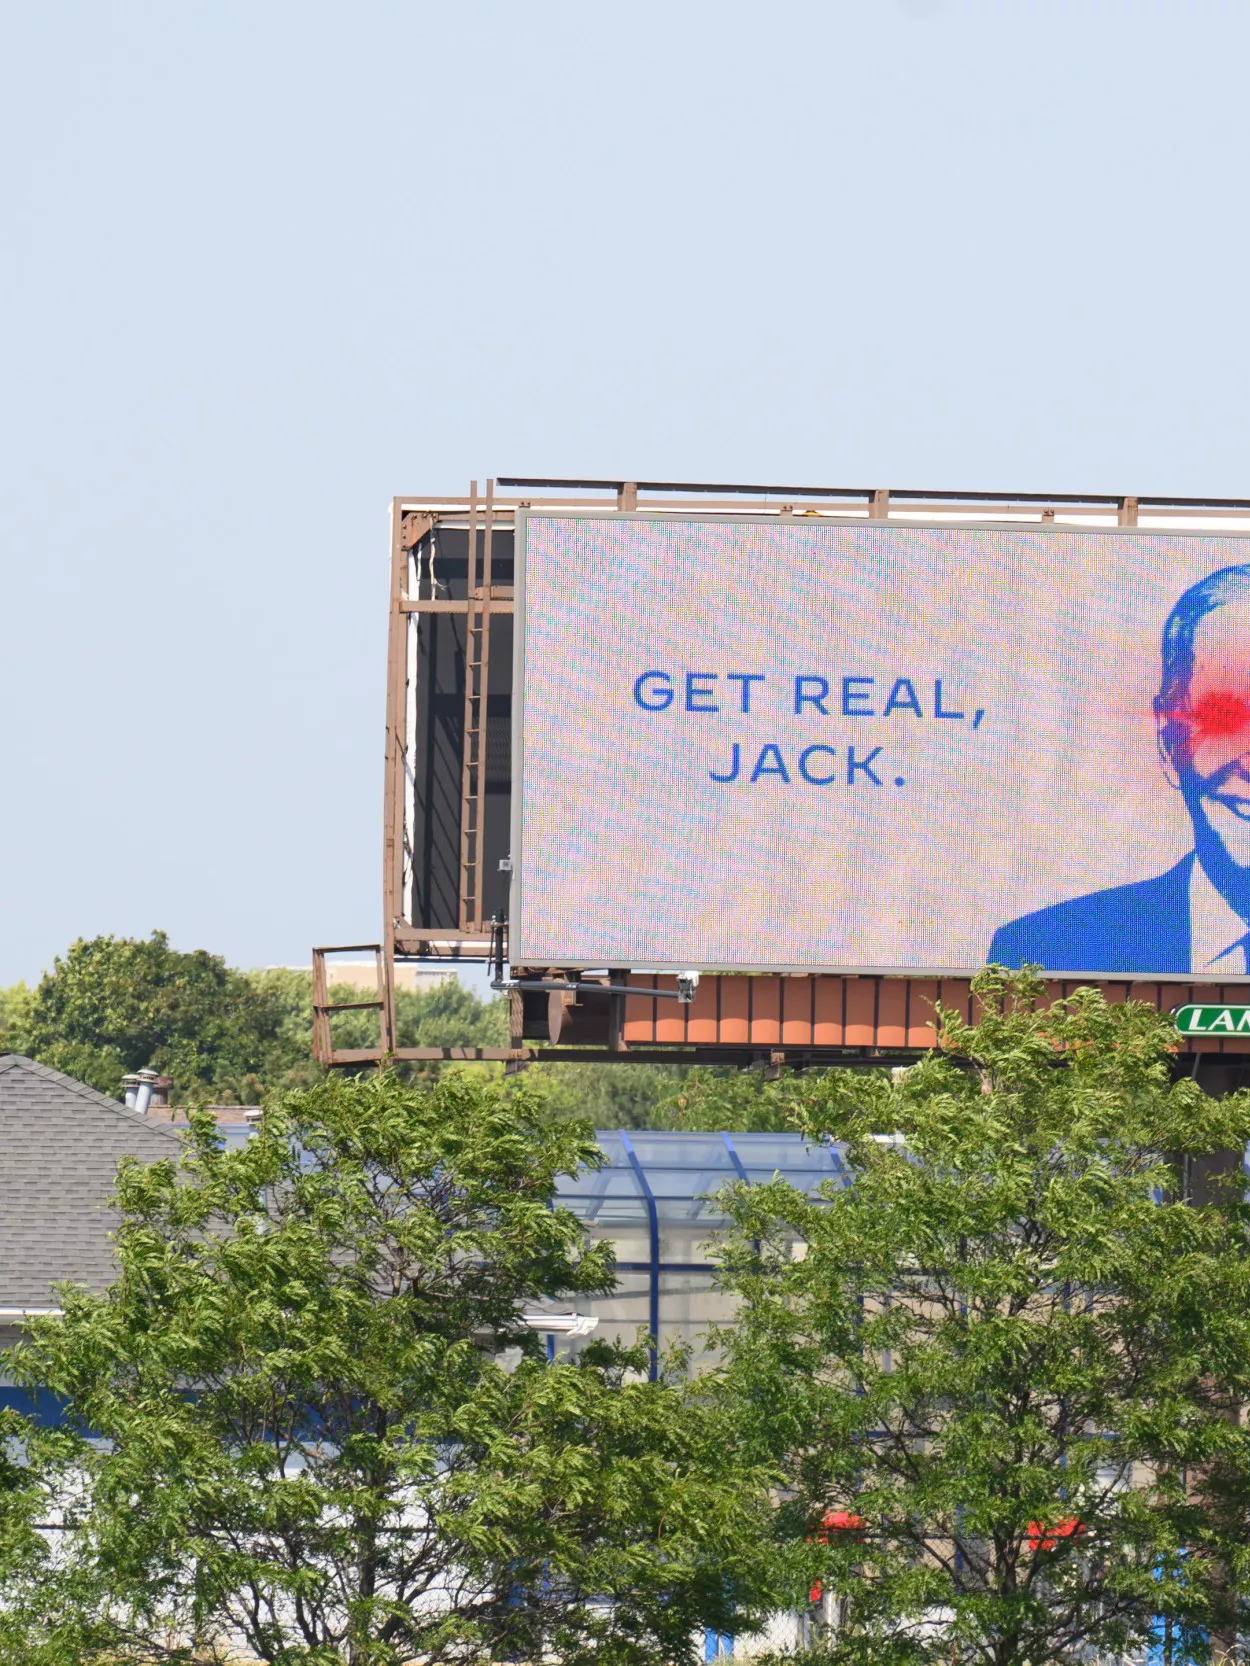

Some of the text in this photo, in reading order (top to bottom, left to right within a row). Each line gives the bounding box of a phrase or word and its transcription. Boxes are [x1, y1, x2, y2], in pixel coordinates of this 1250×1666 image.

[633, 670, 985, 729] GET REAL,
[709, 743, 906, 787] JACK.
